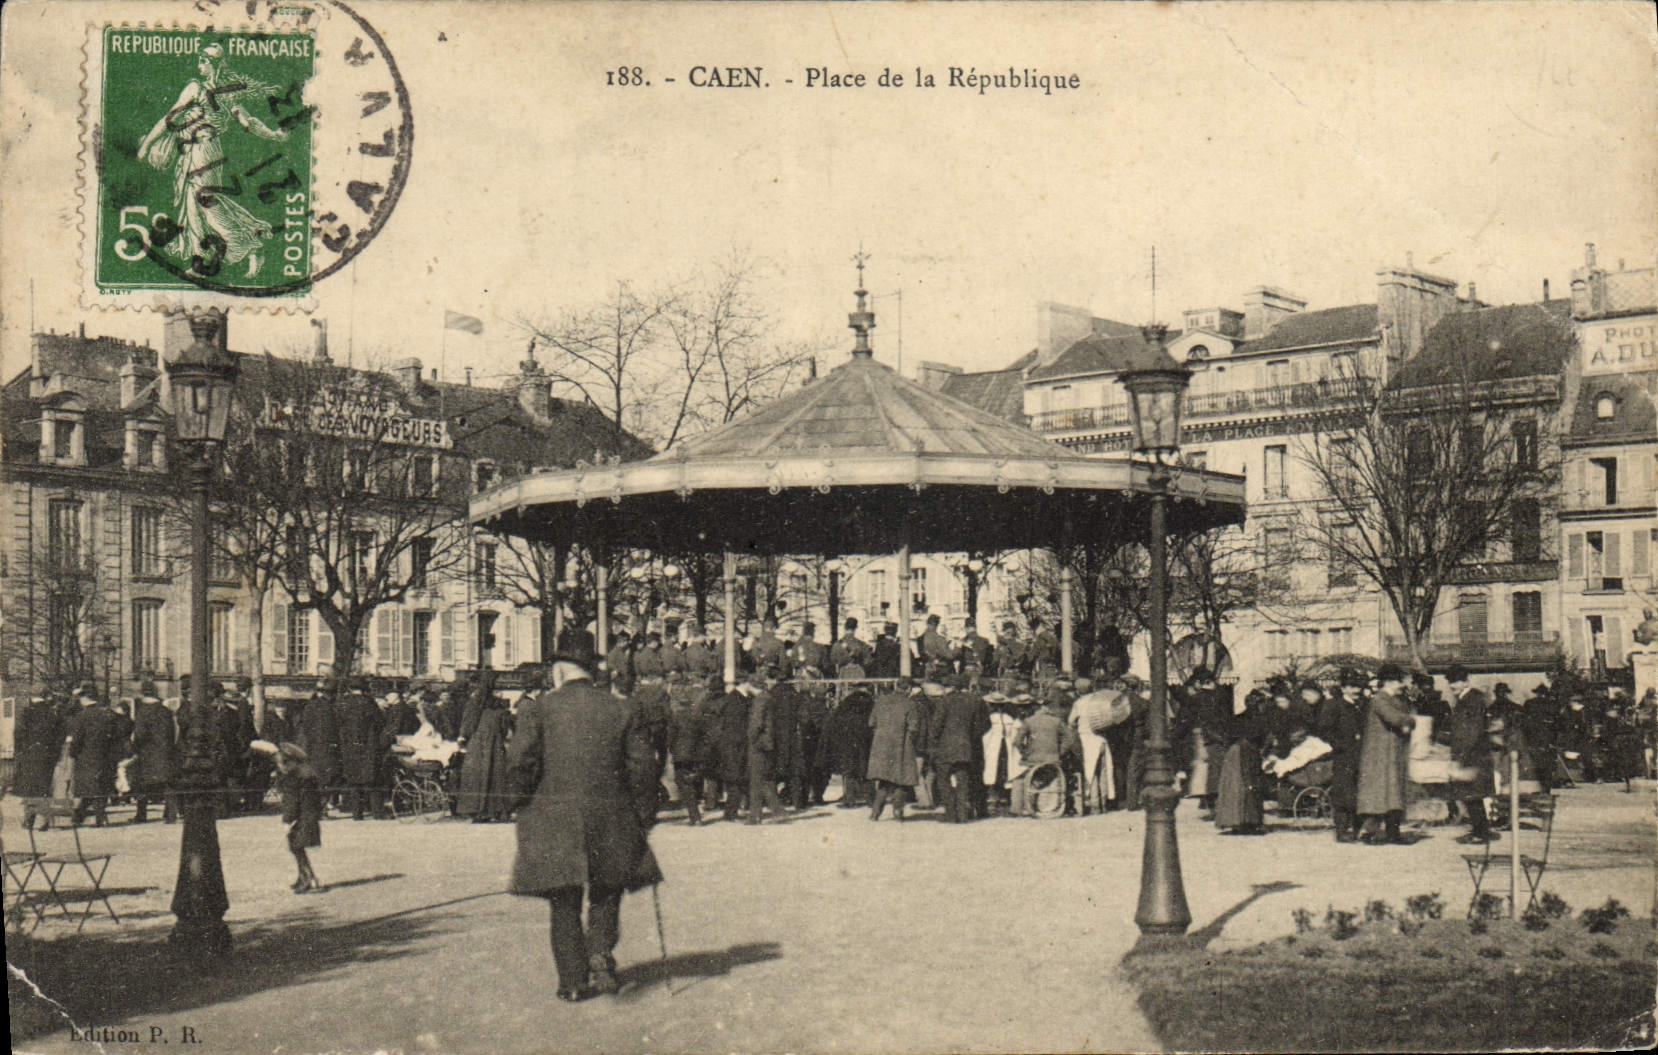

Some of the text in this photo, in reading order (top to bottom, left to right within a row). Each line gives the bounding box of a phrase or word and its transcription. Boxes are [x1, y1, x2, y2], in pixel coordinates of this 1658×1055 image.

[228, 38, 310, 59] FRANÇAISE
[282, 192, 307, 277] POSTES
[349, 413, 442, 444] VOYAGEURS
[1224, 425, 1274, 441] PLACE
